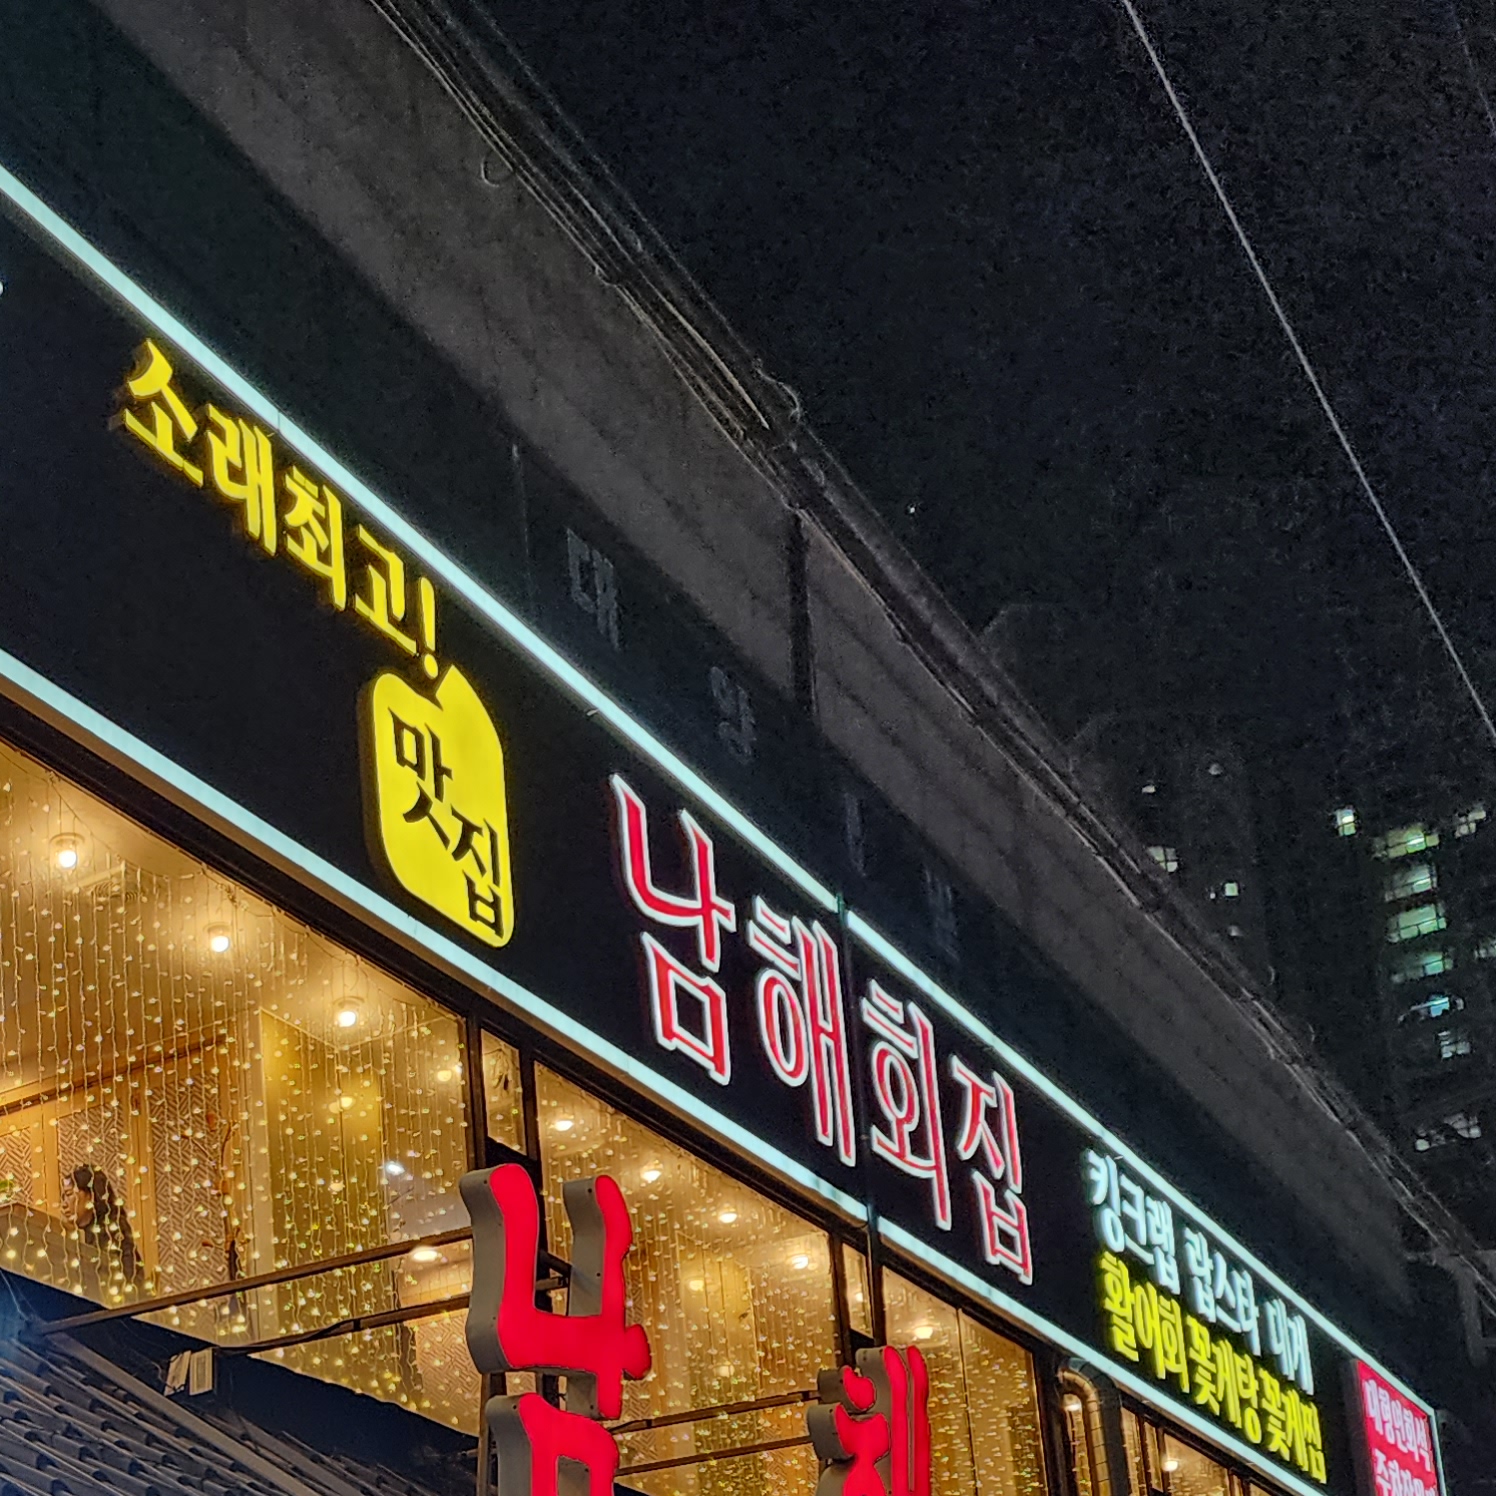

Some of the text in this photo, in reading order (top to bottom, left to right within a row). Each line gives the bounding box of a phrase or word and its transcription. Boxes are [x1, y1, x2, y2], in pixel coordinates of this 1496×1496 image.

[121, 338, 436, 678] 소래최고!
[386, 706, 506, 940] 맛집
[610, 773, 1034, 1286] 남해회집
[1085, 1148, 1180, 1296] 킹크랩
[1265, 1298, 1315, 1395] 대게
[1099, 1251, 1327, 1484] 활어회 꽃게탕 꽃게찜
